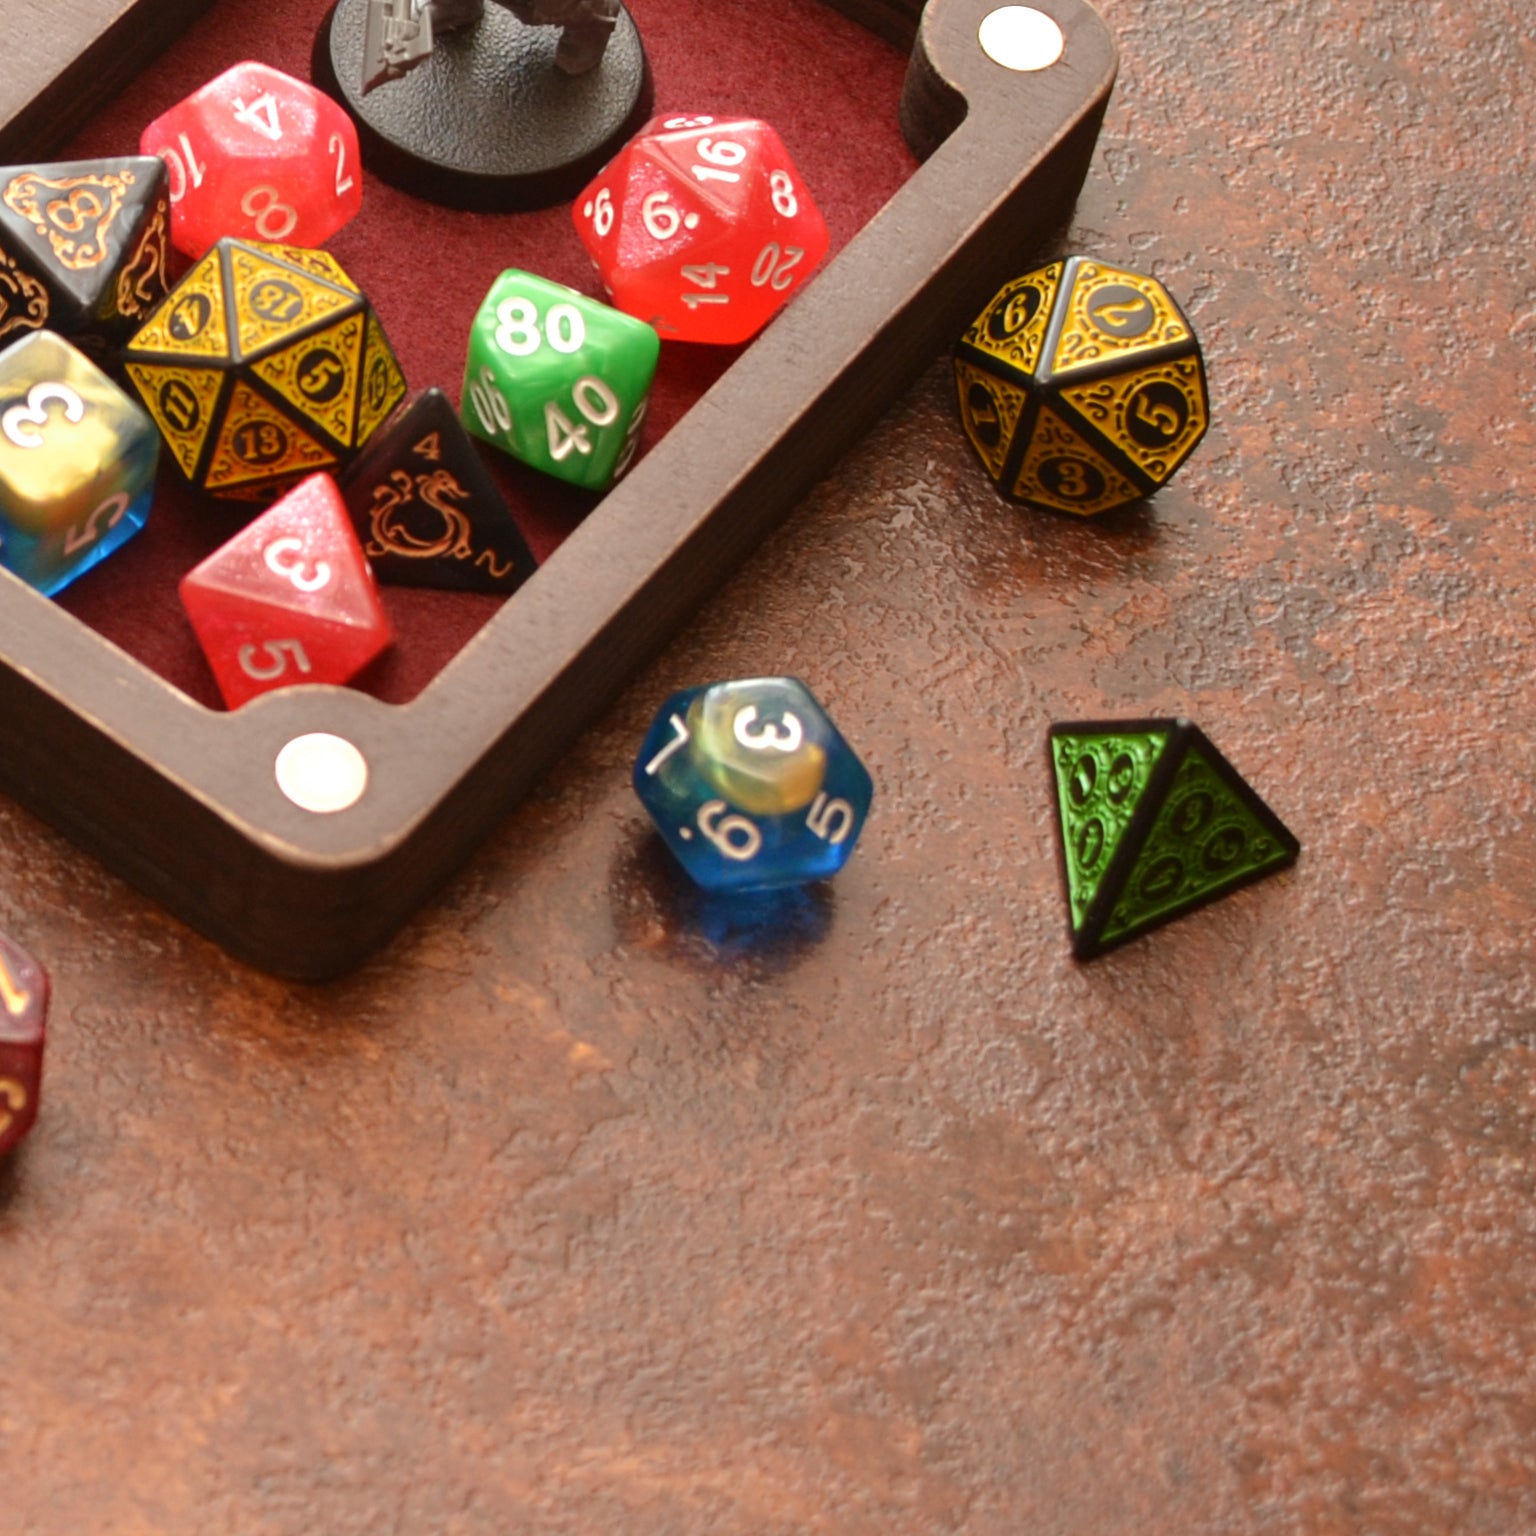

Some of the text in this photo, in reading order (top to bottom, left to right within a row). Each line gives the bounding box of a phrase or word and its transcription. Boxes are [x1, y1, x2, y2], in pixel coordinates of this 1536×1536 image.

[234, 94, 283, 140] 4
[329, 133, 353, 196] 2
[692, 138, 746, 184] 16
[47, 190, 102, 231] 8
[241, 184, 298, 239] 8
[770, 169, 797, 218] 8
[681, 262, 730, 309] 14
[750, 242, 804, 290] 20
[495, 297, 585, 356] 80
[301, 358, 339, 391] 5
[2, 382, 84, 449] 3
[166, 395, 195, 426] 11
[545, 375, 620, 461] 40
[1135, 394, 1178, 435] 5
[242, 426, 280, 457] 13
[412, 433, 442, 460] 4
[1057, 460, 1087, 496] 3
[65, 492, 129, 555] 5
[264, 538, 331, 592] 3
[239, 639, 311, 680] 5
[645, 714, 689, 775] 7
[734, 705, 802, 752] 3
[806, 792, 853, 844] 5
